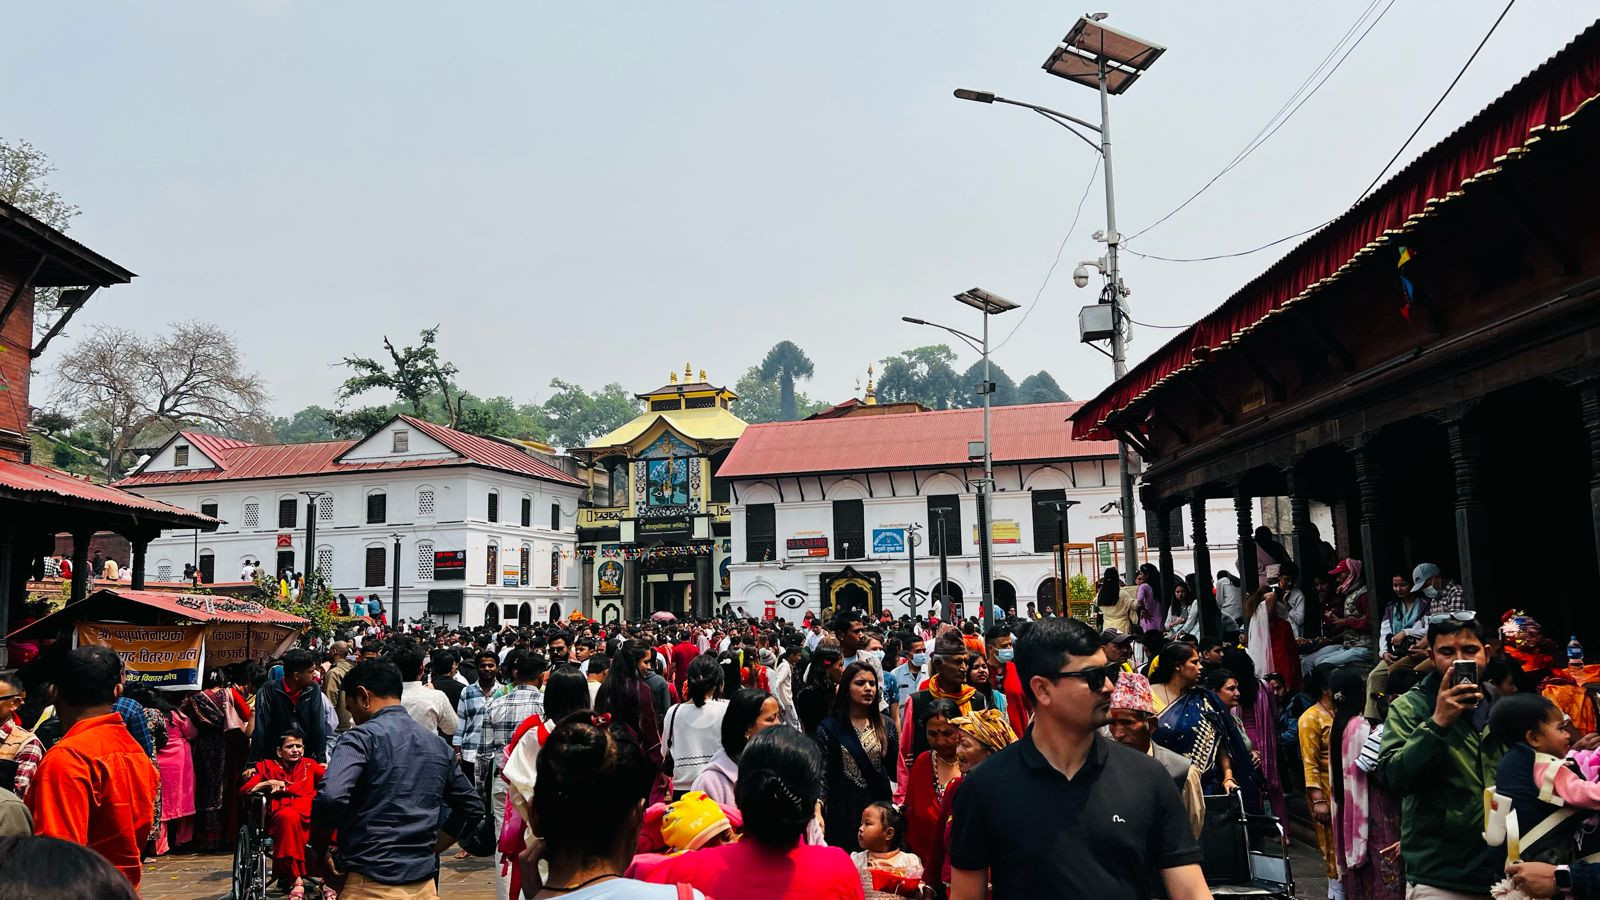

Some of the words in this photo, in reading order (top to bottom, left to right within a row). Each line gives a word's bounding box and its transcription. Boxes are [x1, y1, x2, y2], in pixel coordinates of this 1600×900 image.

[97, 627, 112, 640] श्री
[139, 648, 175, 663] वितरण
[141, 673, 163, 682] विकास
